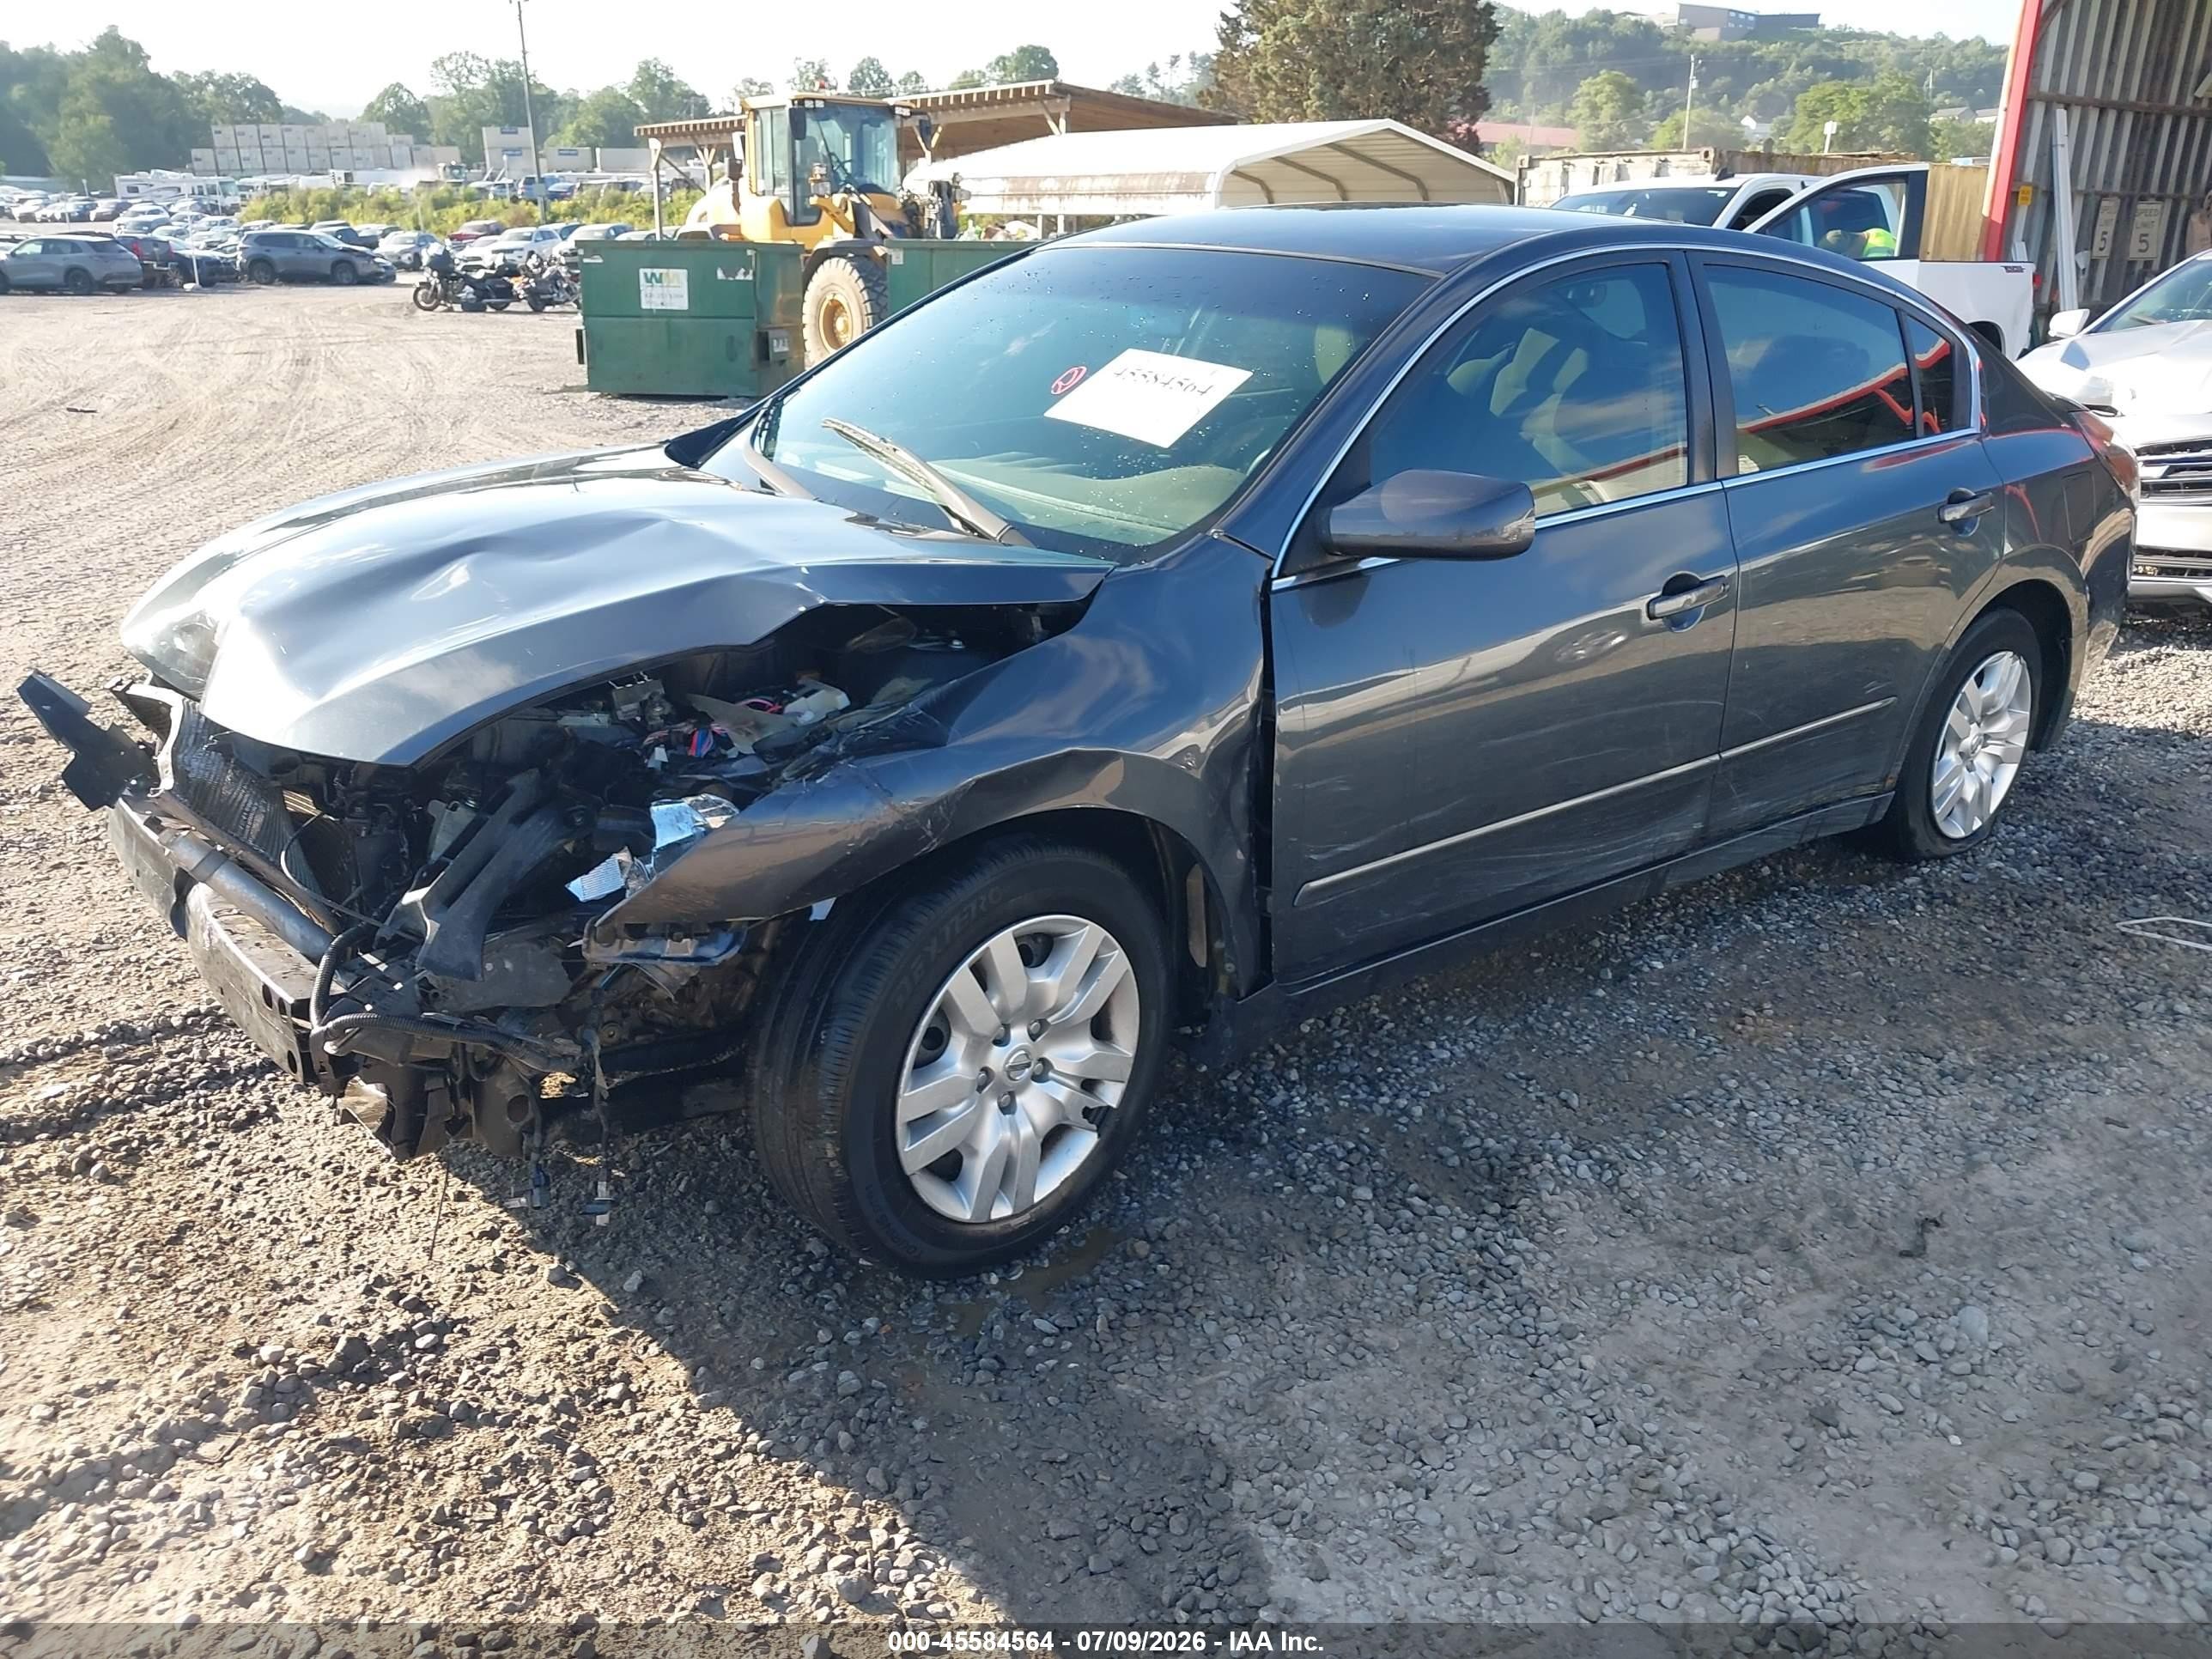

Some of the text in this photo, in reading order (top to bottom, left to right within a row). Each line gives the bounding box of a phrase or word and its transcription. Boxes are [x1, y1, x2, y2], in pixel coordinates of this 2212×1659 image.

[2098, 230, 2109, 252] 5
[2137, 233, 2149, 253] 5
[643, 271, 681, 284] WM
